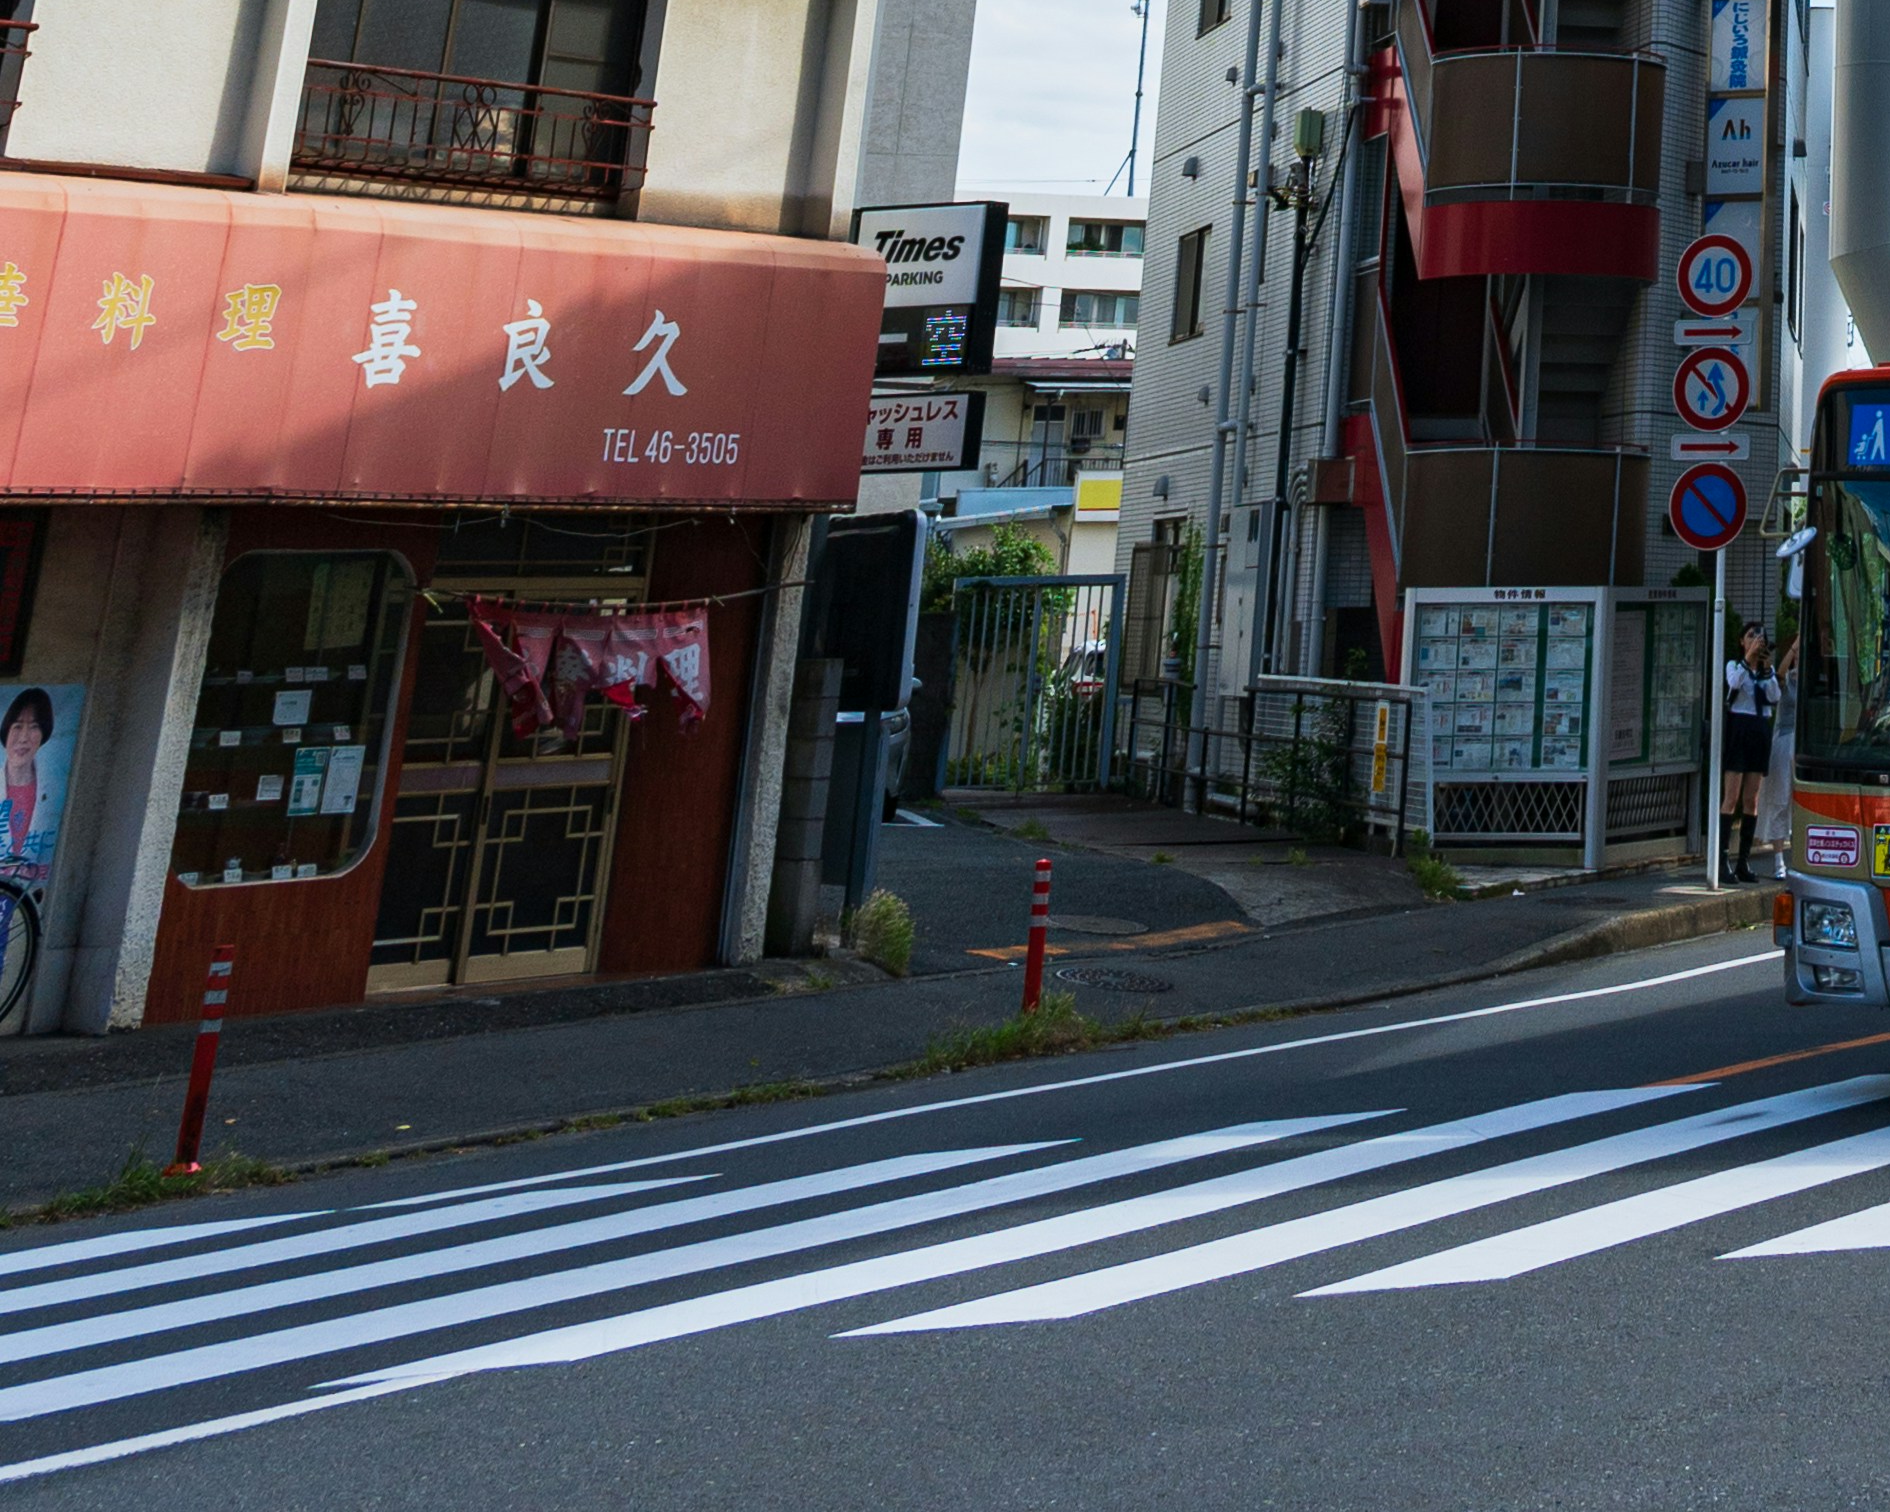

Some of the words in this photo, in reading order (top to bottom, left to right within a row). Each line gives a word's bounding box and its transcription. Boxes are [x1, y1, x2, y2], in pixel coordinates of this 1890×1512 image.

[1711, 159, 1740, 169] Azucar
[1742, 158, 1760, 168] hair
[874, 229, 966, 264] Times
[886, 270, 943, 286] PARKING
[1694, 257, 1736, 294] 40
[351, 288, 690, 398] 喜良久
[867, 400, 958, 425] ャッシュレス
[601, 428, 640, 464] TEL
[645, 430, 740, 466] 46-3505
[876, 427, 923, 450] 専用
[1494, 588, 1546, 600] 物件情報
